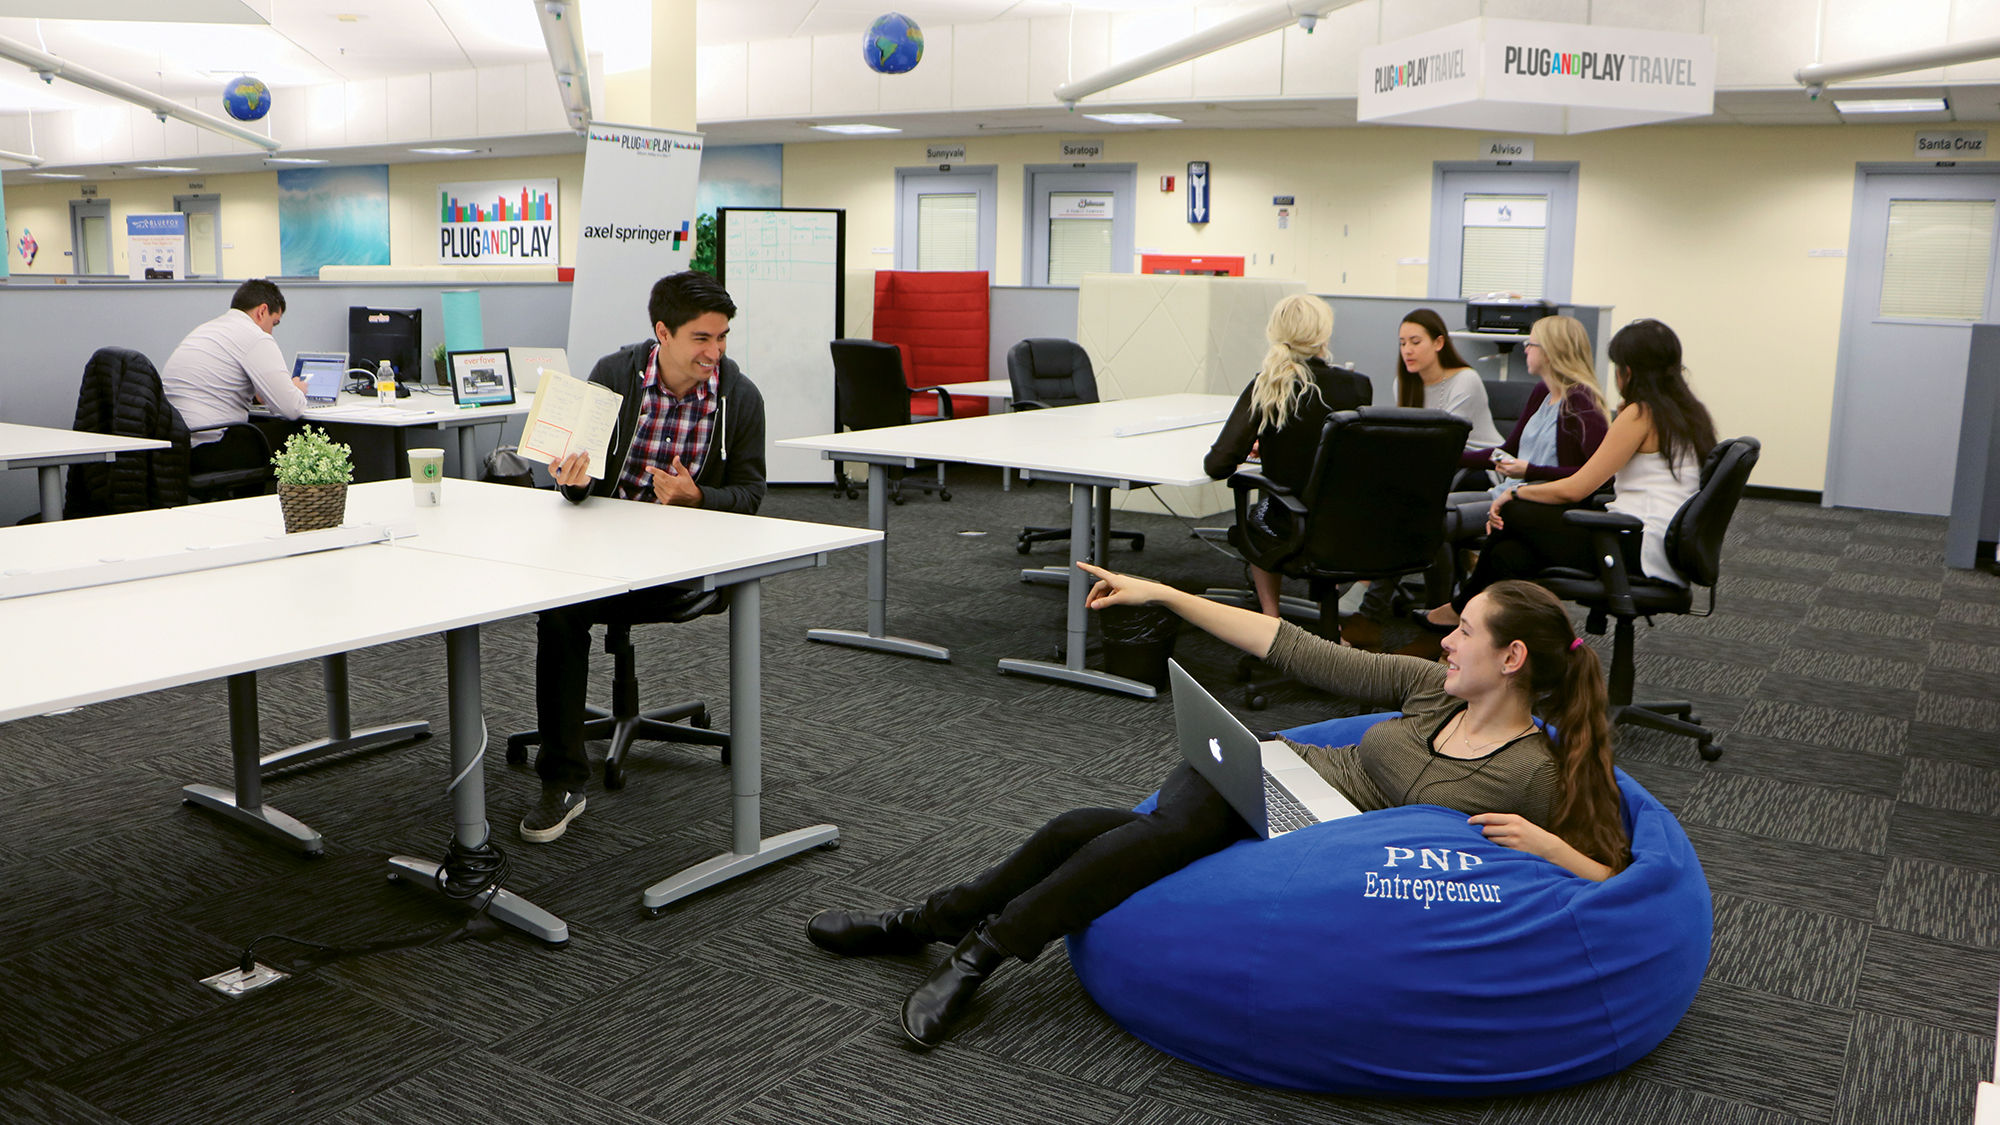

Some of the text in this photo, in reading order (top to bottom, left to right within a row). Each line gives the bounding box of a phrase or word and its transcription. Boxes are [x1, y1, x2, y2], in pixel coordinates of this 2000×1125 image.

[1374, 48, 1466, 94] PLUGANDPLAY TRAVEL
[1504, 46, 1696, 87] PLUGANDPLAY TRAVEL
[621, 134, 673, 153] PLUGANDPLAY
[927, 148, 964, 160] Sunnyvale
[1063, 145, 1099, 157] Saratoga
[1490, 143, 1522, 155] Alviso
[1918, 137, 1982, 150] Santa Cruz
[441, 225, 552, 258] PLUGANDPLAY
[584, 223, 672, 244] axel springer
[1383, 846, 1483, 871] PNP
[1363, 871, 1502, 910] Entrepreneur
